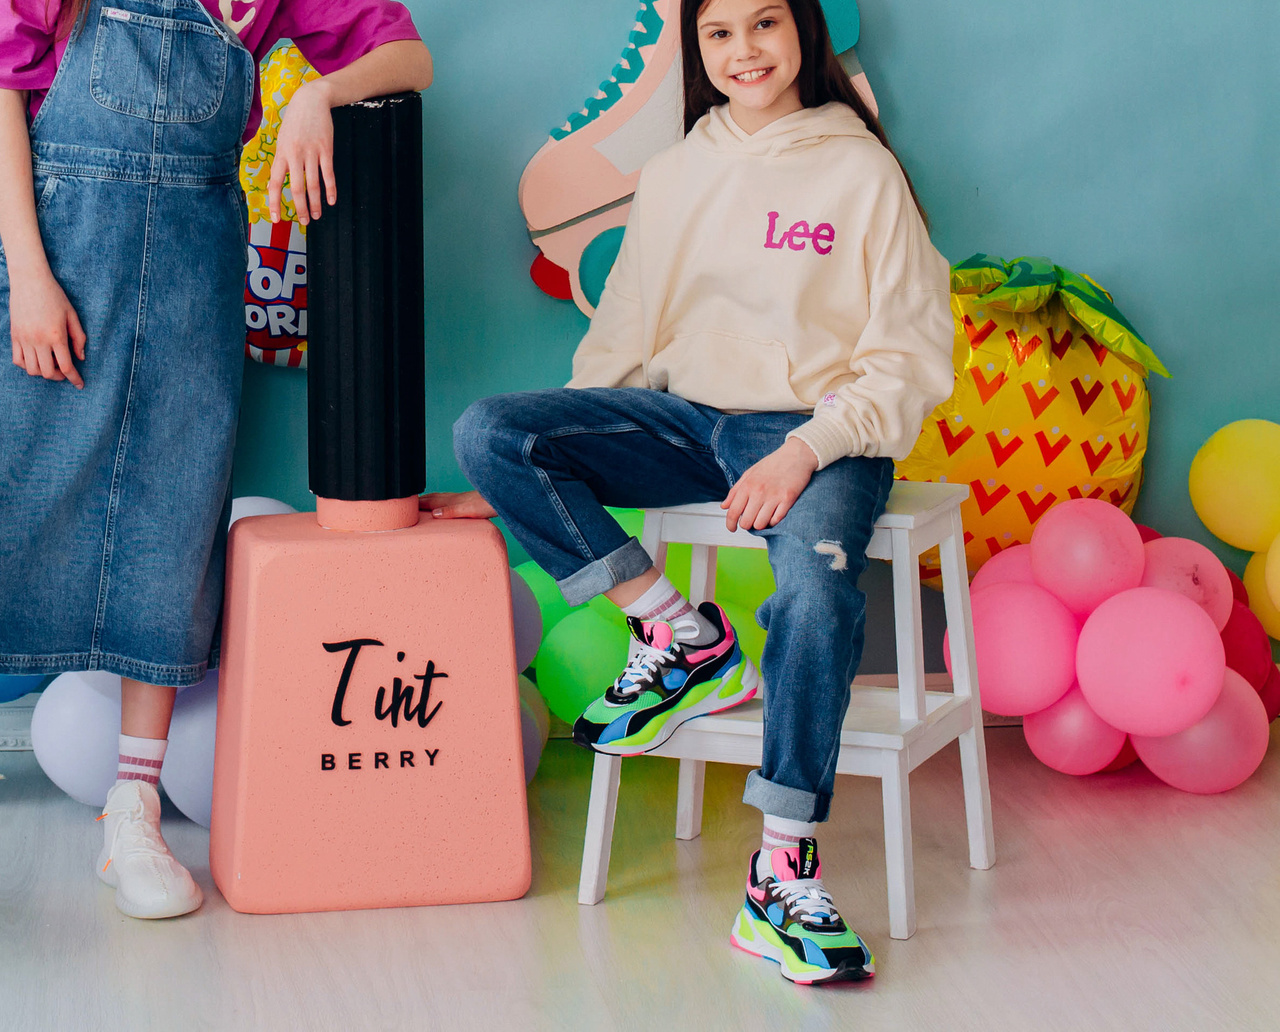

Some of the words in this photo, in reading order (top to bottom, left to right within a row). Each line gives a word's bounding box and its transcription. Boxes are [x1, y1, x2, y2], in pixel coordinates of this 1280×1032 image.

[764, 211, 835, 255] Lee
[322, 638, 449, 729] Tint
[321, 749, 440, 771] BERRY
